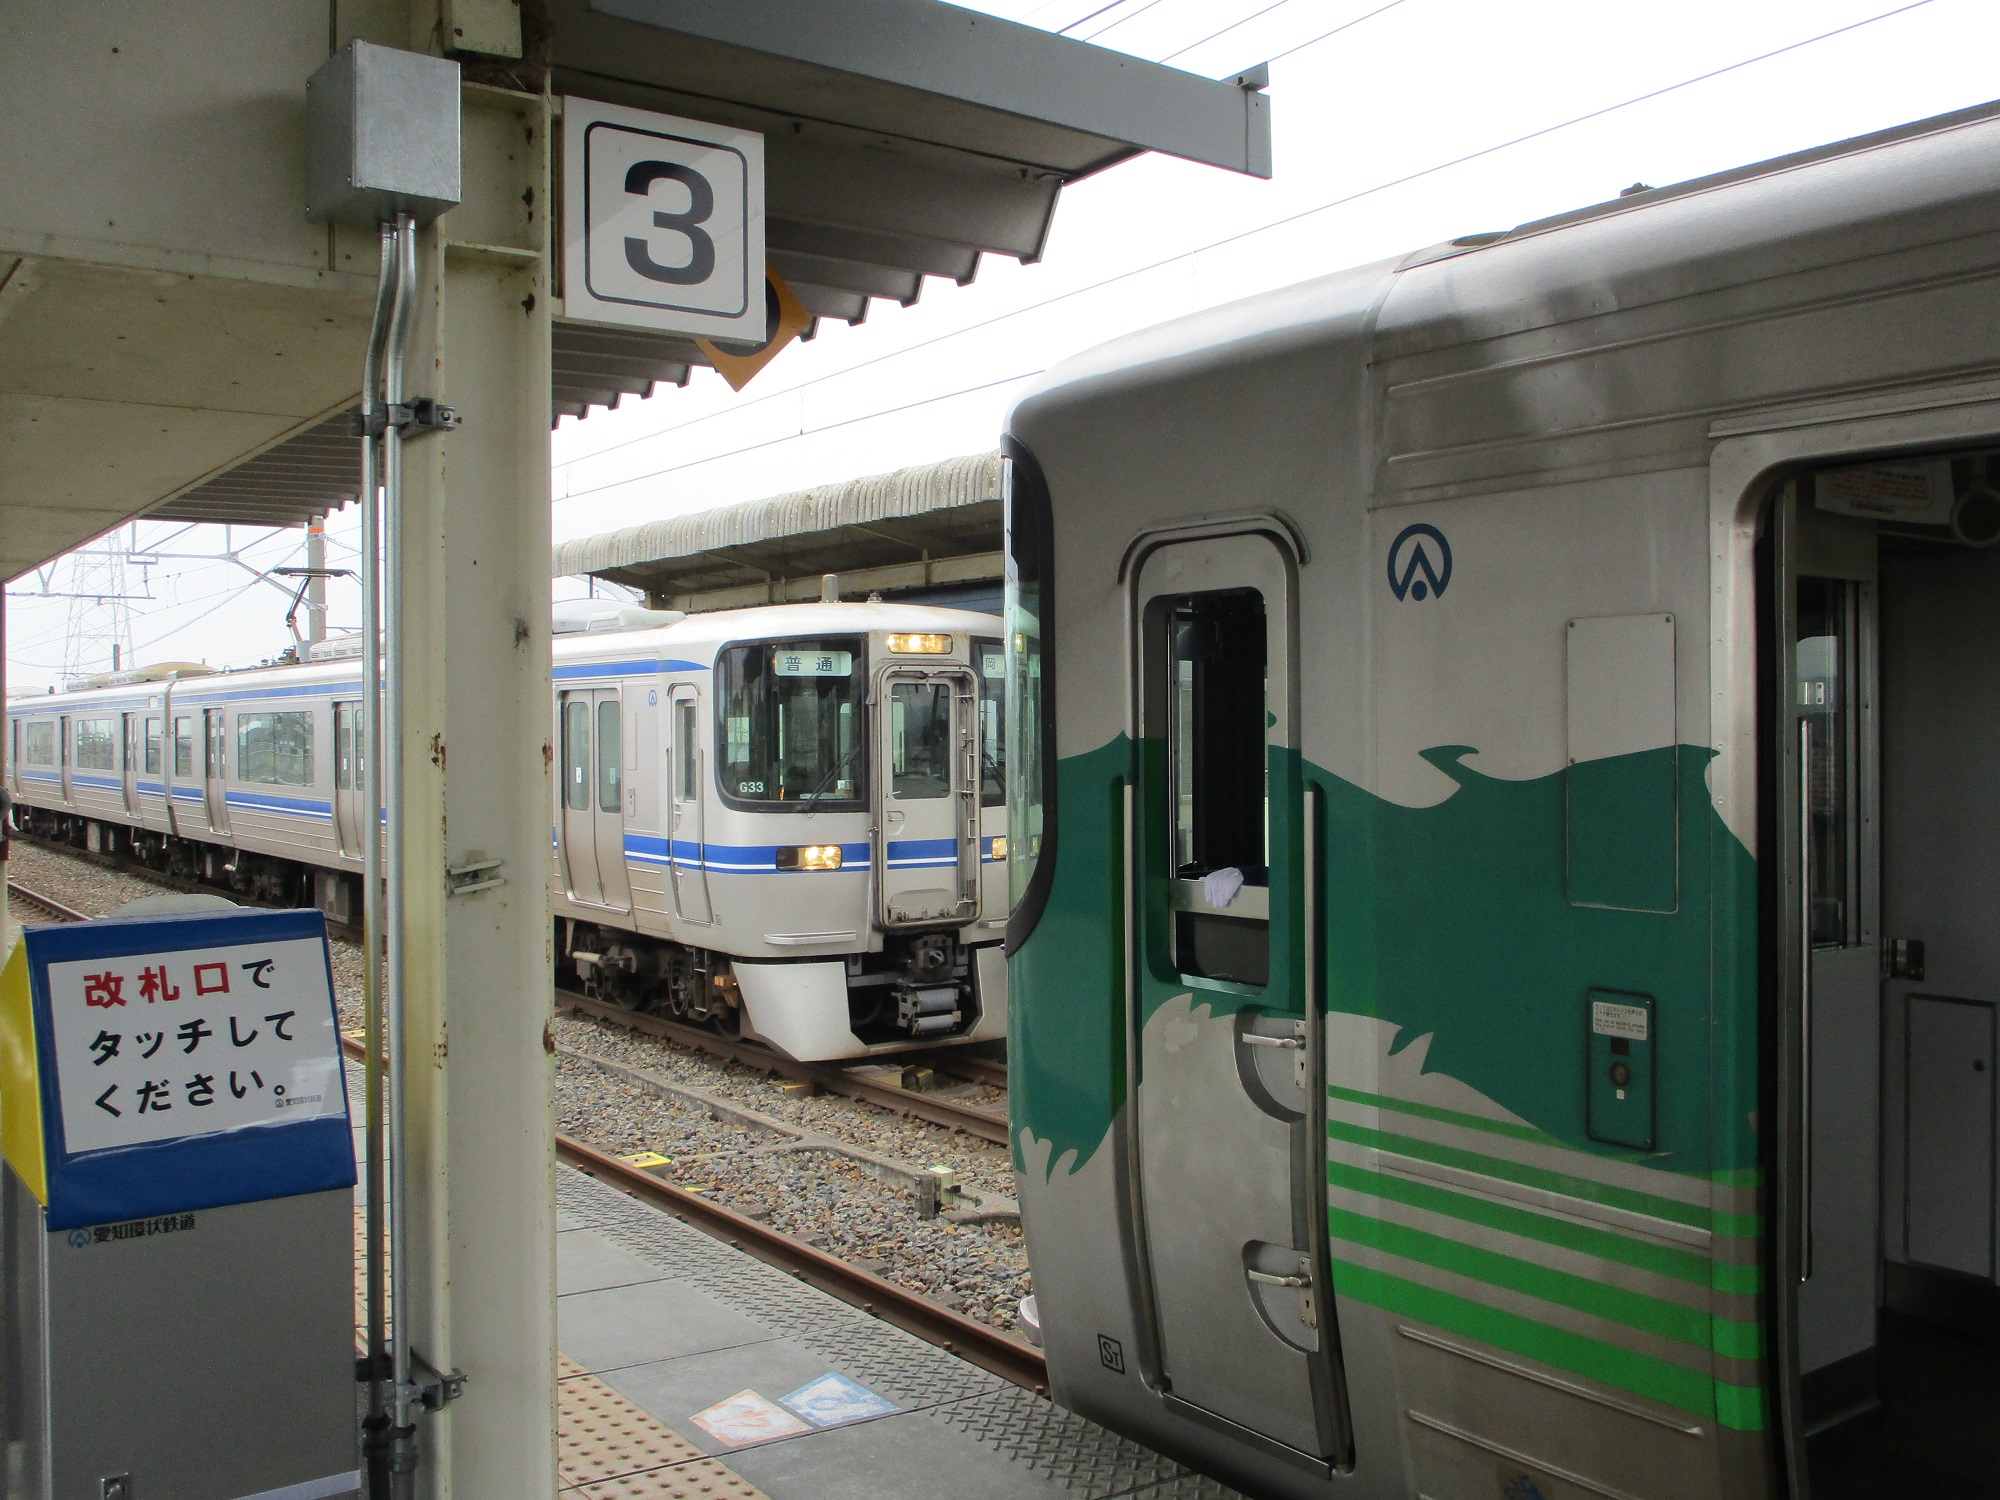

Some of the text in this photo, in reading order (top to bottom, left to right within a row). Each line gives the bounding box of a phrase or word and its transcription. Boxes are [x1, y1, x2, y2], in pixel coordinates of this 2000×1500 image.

[623, 159, 716, 286] 3
[785, 655, 833, 673] 普通
[739, 781, 765, 794] G33
[83, 957, 277, 1009] 改札口で
[88, 1010, 297, 1067] タッチして
[95, 1070, 286, 1118] ください。
[93, 1214, 196, 1244] 愛知環状鉄道
